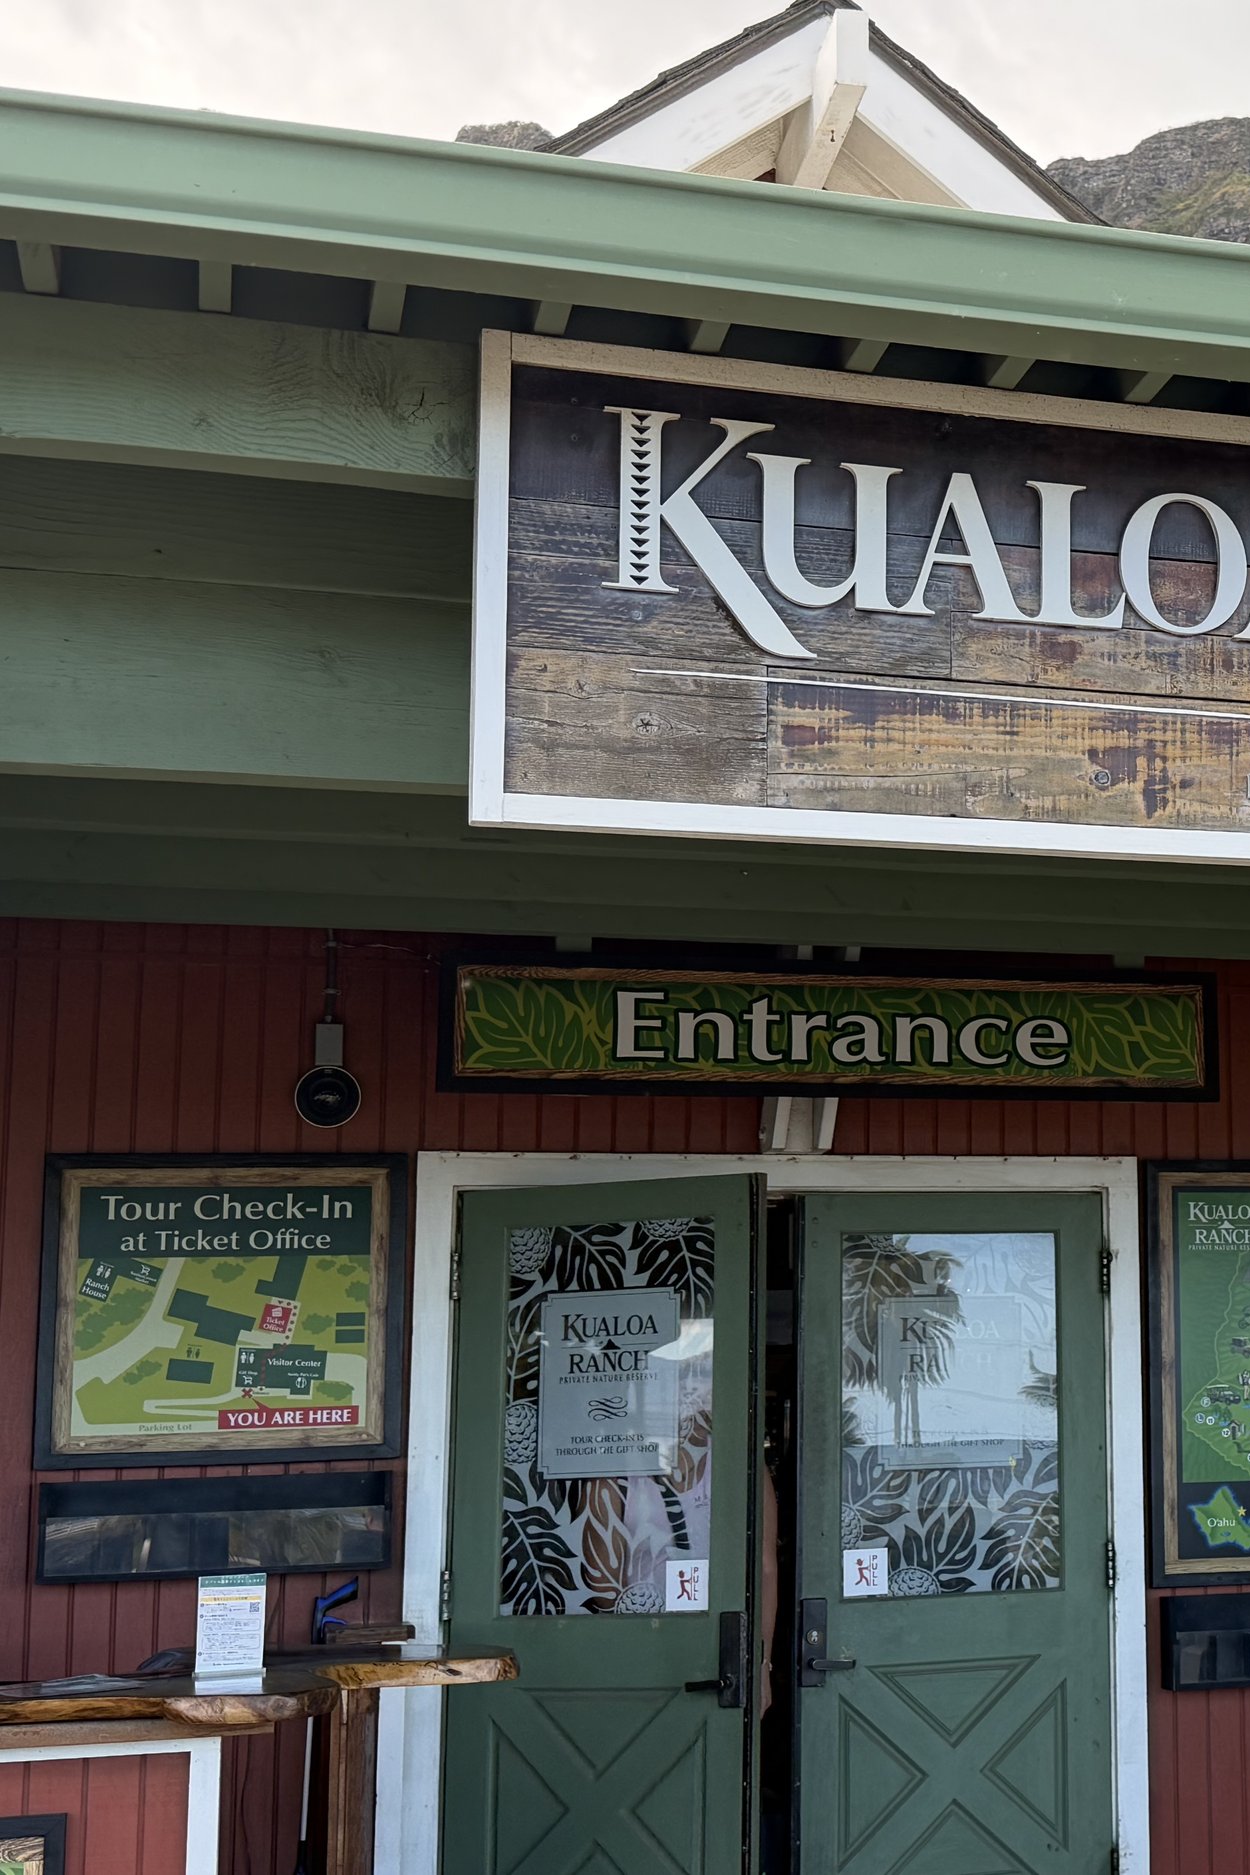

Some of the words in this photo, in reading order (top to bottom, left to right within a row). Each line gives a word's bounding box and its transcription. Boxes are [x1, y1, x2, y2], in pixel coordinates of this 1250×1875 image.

[612, 989, 1070, 1067] Entrance
[101, 1196, 181, 1221] Tour
[194, 1194, 353, 1220] Check-In
[120, 1232, 147, 1251] at
[155, 1230, 240, 1251] Ticket
[249, 1229, 331, 1250] Office
[85, 1278, 109, 1291] Ranch
[82, 1286, 107, 1299] House
[263, 1324, 284, 1332] Office
[267, 1317, 285, 1326] Ticket
[561, 1314, 658, 1342] KUALOA
[295, 1359, 322, 1367] Center
[568, 1350, 650, 1374] RANCH
[559, 1376, 590, 1384] PRIVATE
[593, 1374, 623, 1382] NATURE
[139, 1424, 175, 1432] Parking
[227, 1412, 267, 1426] YOU
[271, 1411, 303, 1424] ARE
[309, 1409, 351, 1423] HERE
[571, 1436, 592, 1444] TOUR
[981, 1438, 1005, 1446] SHOP
[556, 1447, 597, 1456] THROUGH
